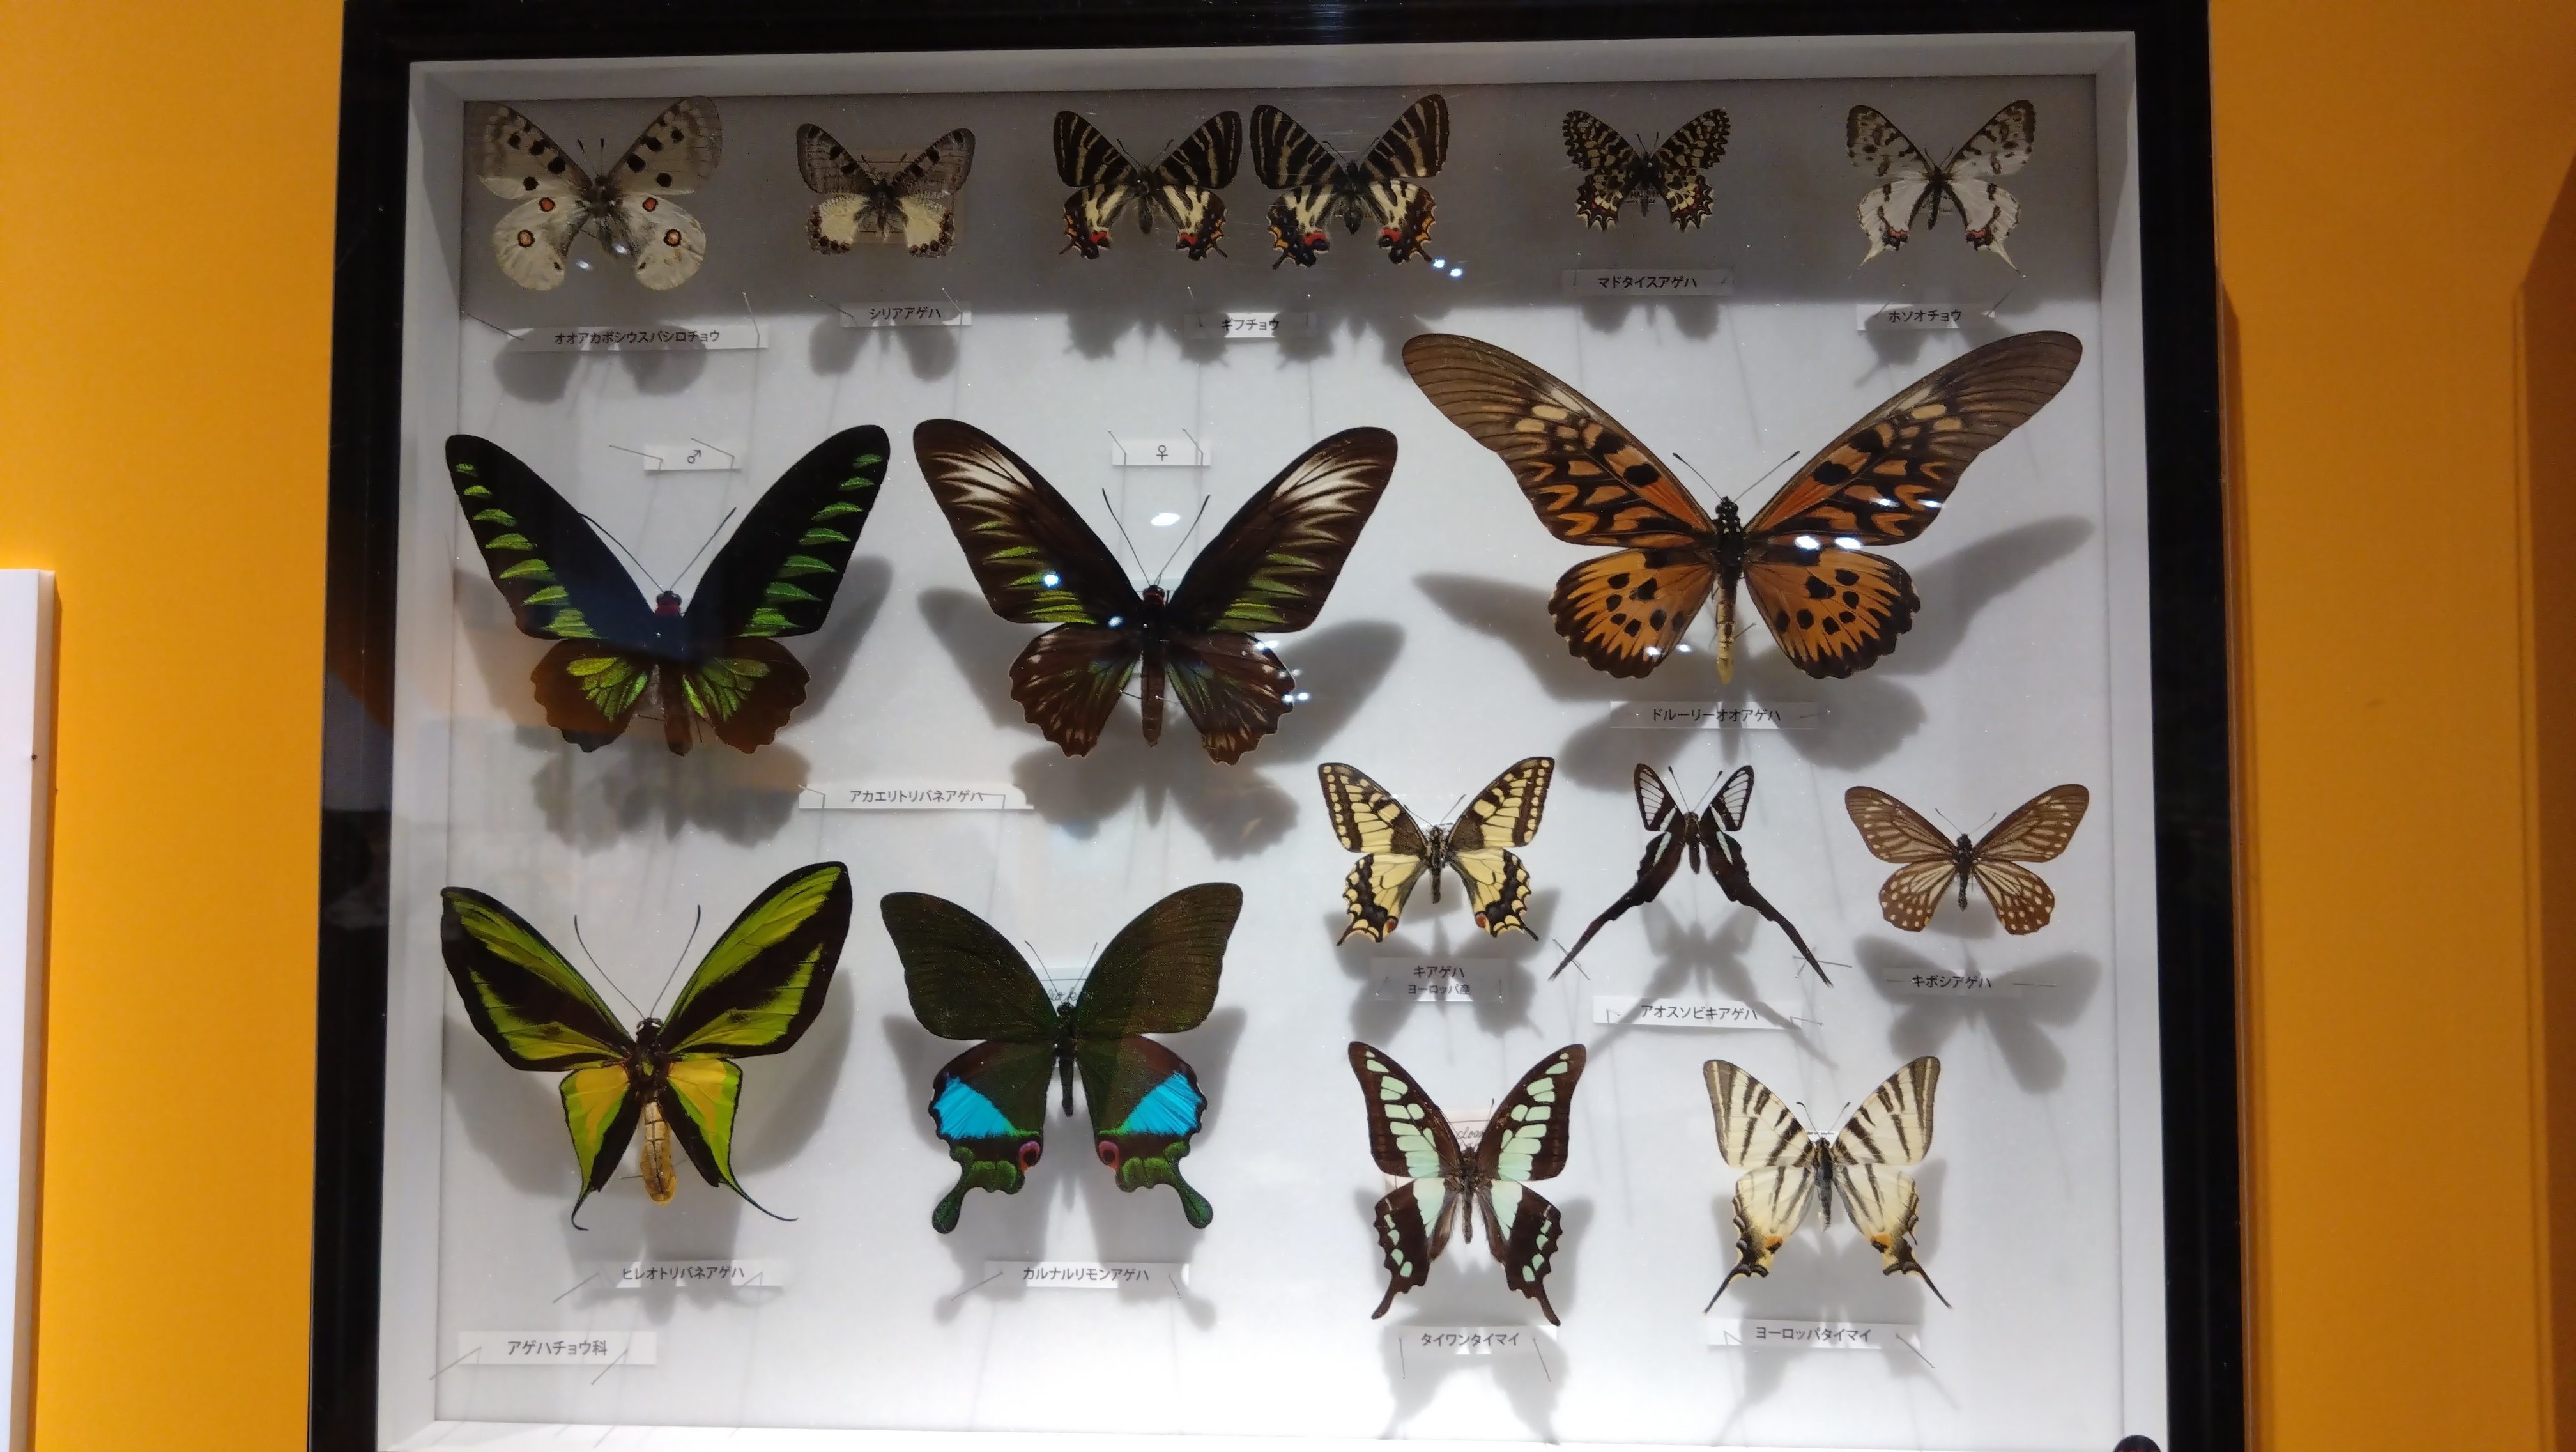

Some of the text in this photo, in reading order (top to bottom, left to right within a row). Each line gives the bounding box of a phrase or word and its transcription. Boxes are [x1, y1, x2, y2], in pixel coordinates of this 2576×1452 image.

[1598, 276, 1697, 288] マドタイスアゲハ
[870, 307, 941, 320] シリアアゲハ
[1889, 309, 1962, 323] ホソオチョウ
[1222, 318, 1279, 330] ギフチョウ
[555, 330, 719, 344] オオアカボシウスバシロチョウ
[1654, 709, 1781, 722] ドルーリーオオアゲハ
[850, 790, 984, 803] アカエリトリバネアゲハ
[1414, 966, 1464, 978] キアゲハ
[1912, 975, 1991, 989] キボシアゲハ
[1409, 984, 1470, 994] ヨーロッパ産
[1641, 1005, 1757, 1020] アオスソビキアゲハ
[623, 1266, 744, 1279] ヒレオトリバネアゲハ
[1023, 1267, 1149, 1281] カルナルリモンアゲハ
[1422, 1333, 1519, 1347] タイワンタイマイ
[1756, 1327, 1871, 1341] ヨーロッパタイマイ
[508, 1340, 608, 1355] アゲハチョウ科
